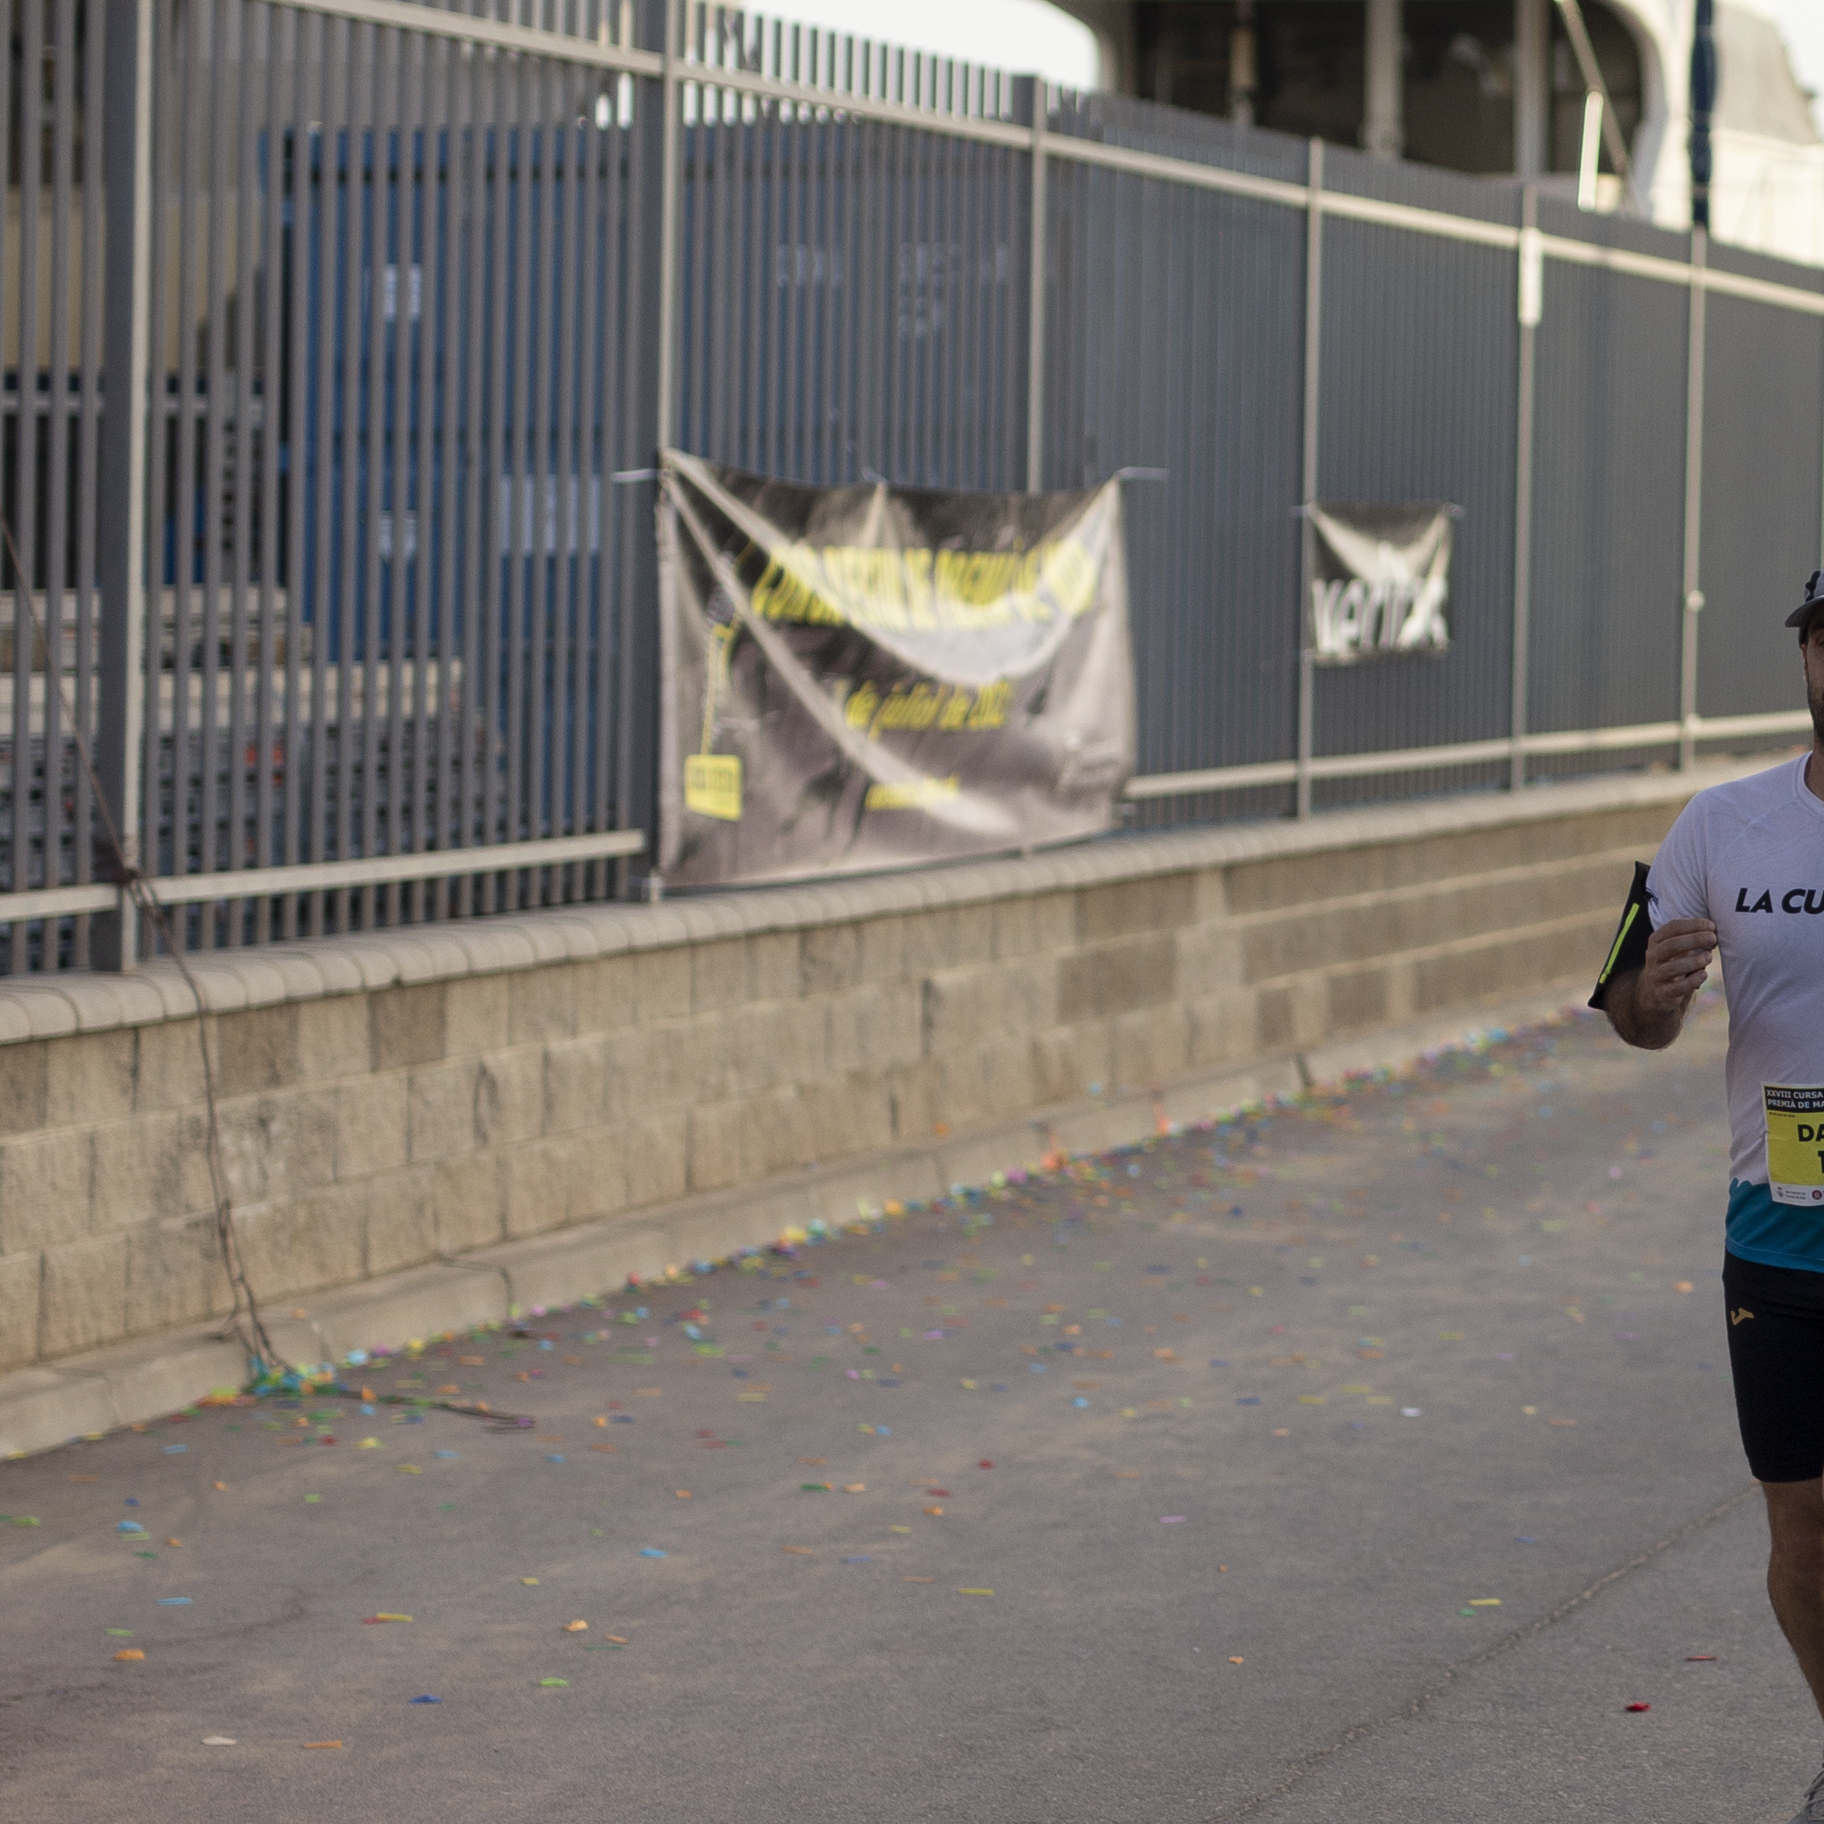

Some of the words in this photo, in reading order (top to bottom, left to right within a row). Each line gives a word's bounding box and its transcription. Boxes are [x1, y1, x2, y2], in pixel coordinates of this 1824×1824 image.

[1735, 887, 1774, 914] LA
[1793, 1090, 1824, 1100] CURSA
[1798, 1101, 1810, 1109] DE
